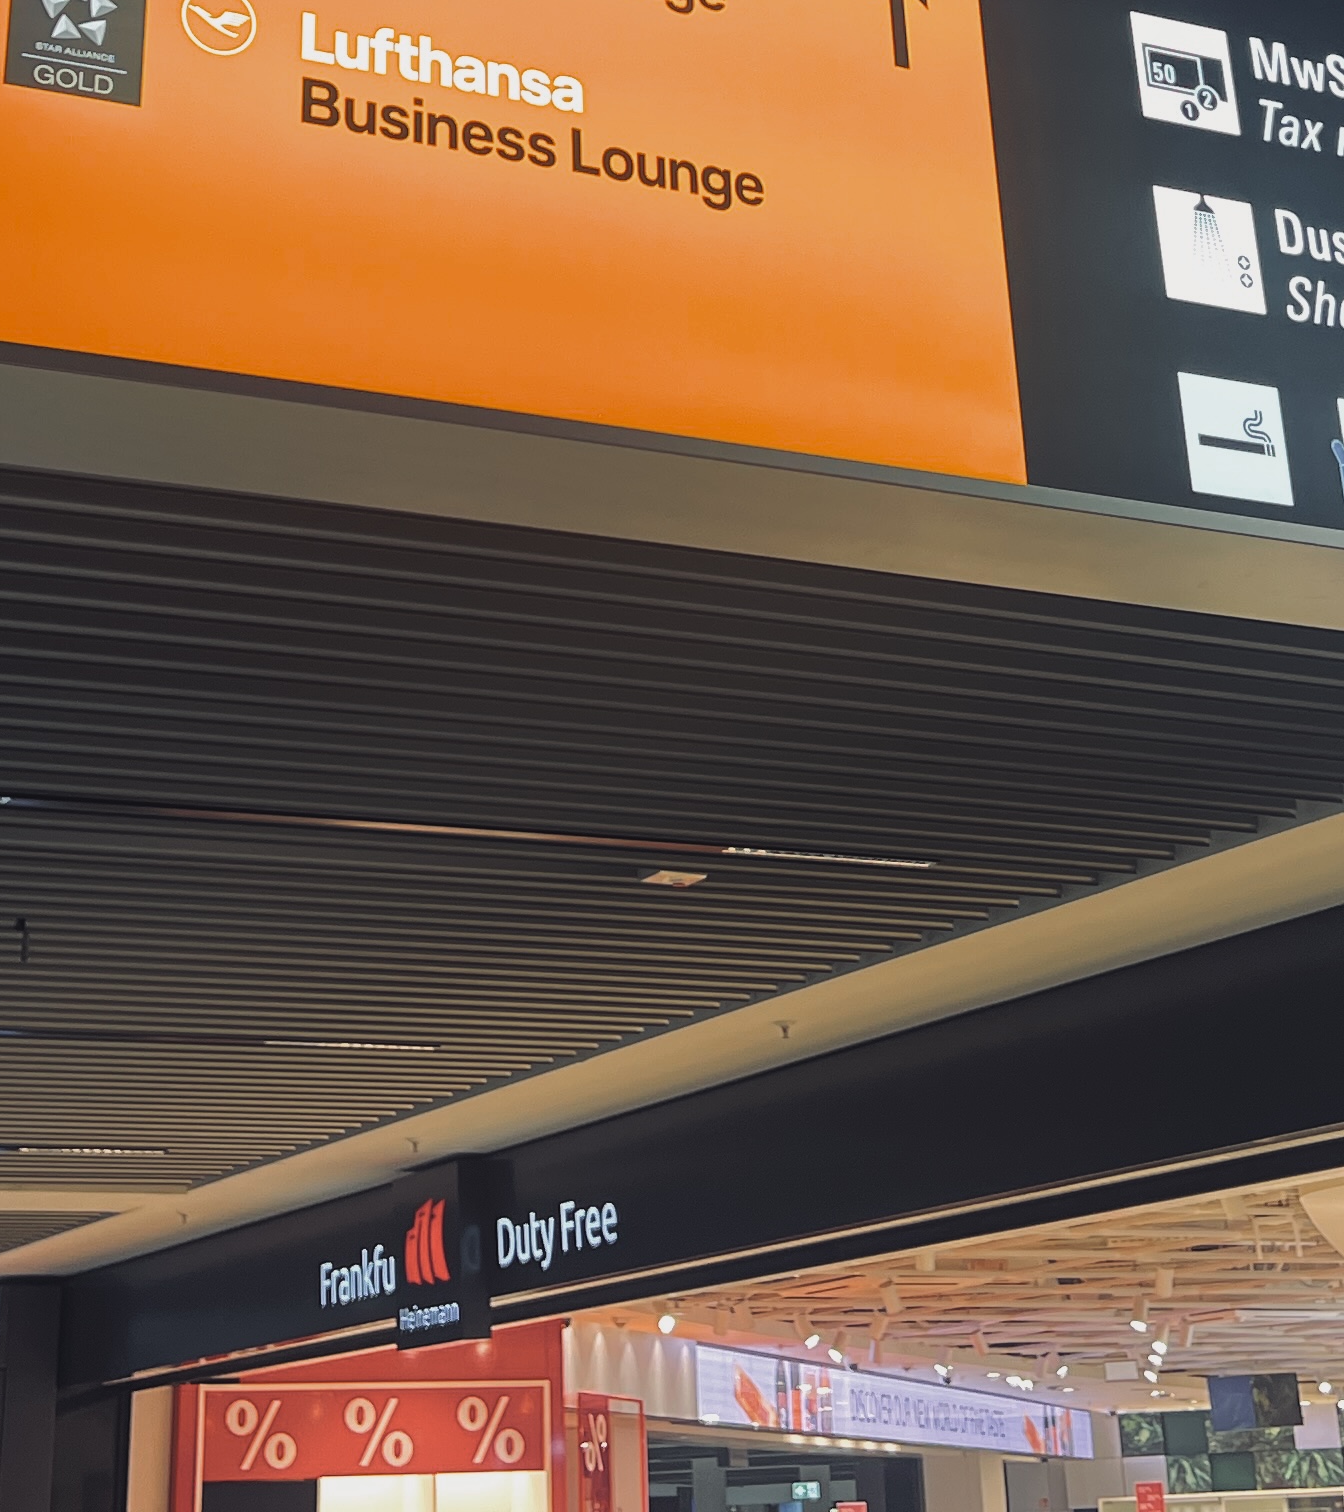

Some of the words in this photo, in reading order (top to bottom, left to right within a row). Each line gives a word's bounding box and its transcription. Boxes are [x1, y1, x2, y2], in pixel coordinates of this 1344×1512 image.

[34, 40, 64, 53] STAR
[64, 46, 116, 63] ALLIANCE
[300, 12, 585, 114] Lufthansa
[32, 64, 114, 95] GOLD
[1152, 61, 1175, 84] 50
[1185, 103, 1194, 118] 1
[1202, 90, 1214, 109] 2
[1258, 98, 1324, 152] Tax
[301, 76, 556, 167] Business
[571, 128, 765, 212] Lounge
[497, 1210, 555, 1271] Duty
[559, 1200, 619, 1252] Free
